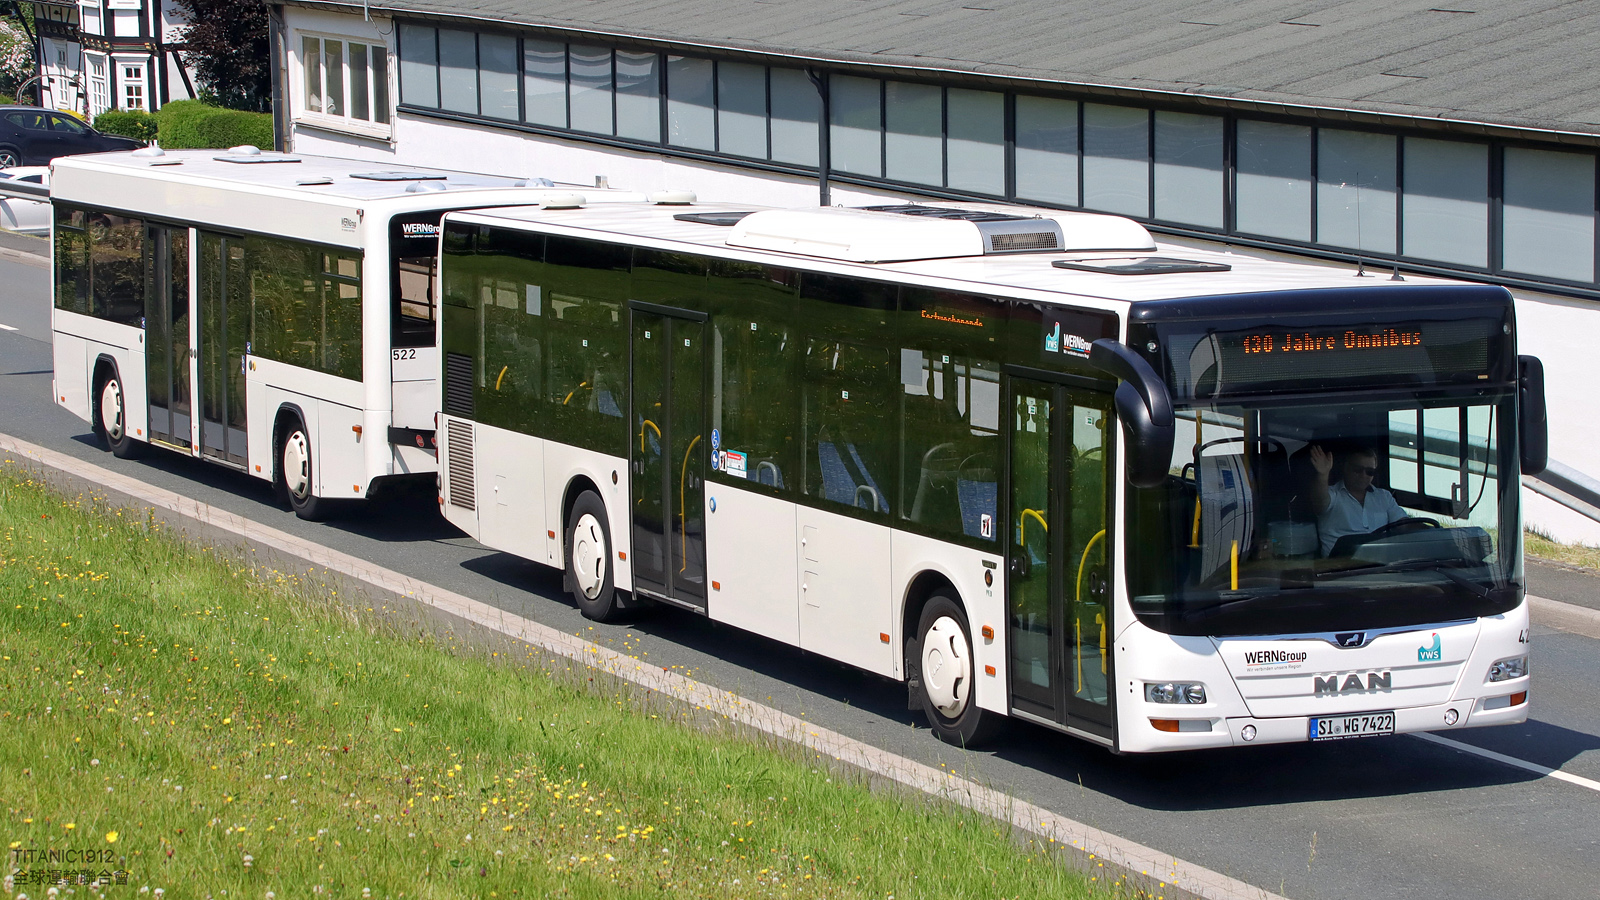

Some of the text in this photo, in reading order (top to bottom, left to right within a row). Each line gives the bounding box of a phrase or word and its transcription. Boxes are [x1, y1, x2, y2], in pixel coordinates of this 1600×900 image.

[402, 223, 440, 233] WERNGro
[1063, 333, 1092, 351] WERNGrou
[1243, 328, 1421, 354] 130 Jahre Omnibus
[393, 348, 416, 361] 522
[1244, 649, 1307, 664] WERNGroup
[1420, 650, 1439, 660] VWS
[1314, 671, 1392, 697] MAN
[1318, 715, 1392, 736] SI WG 7422
